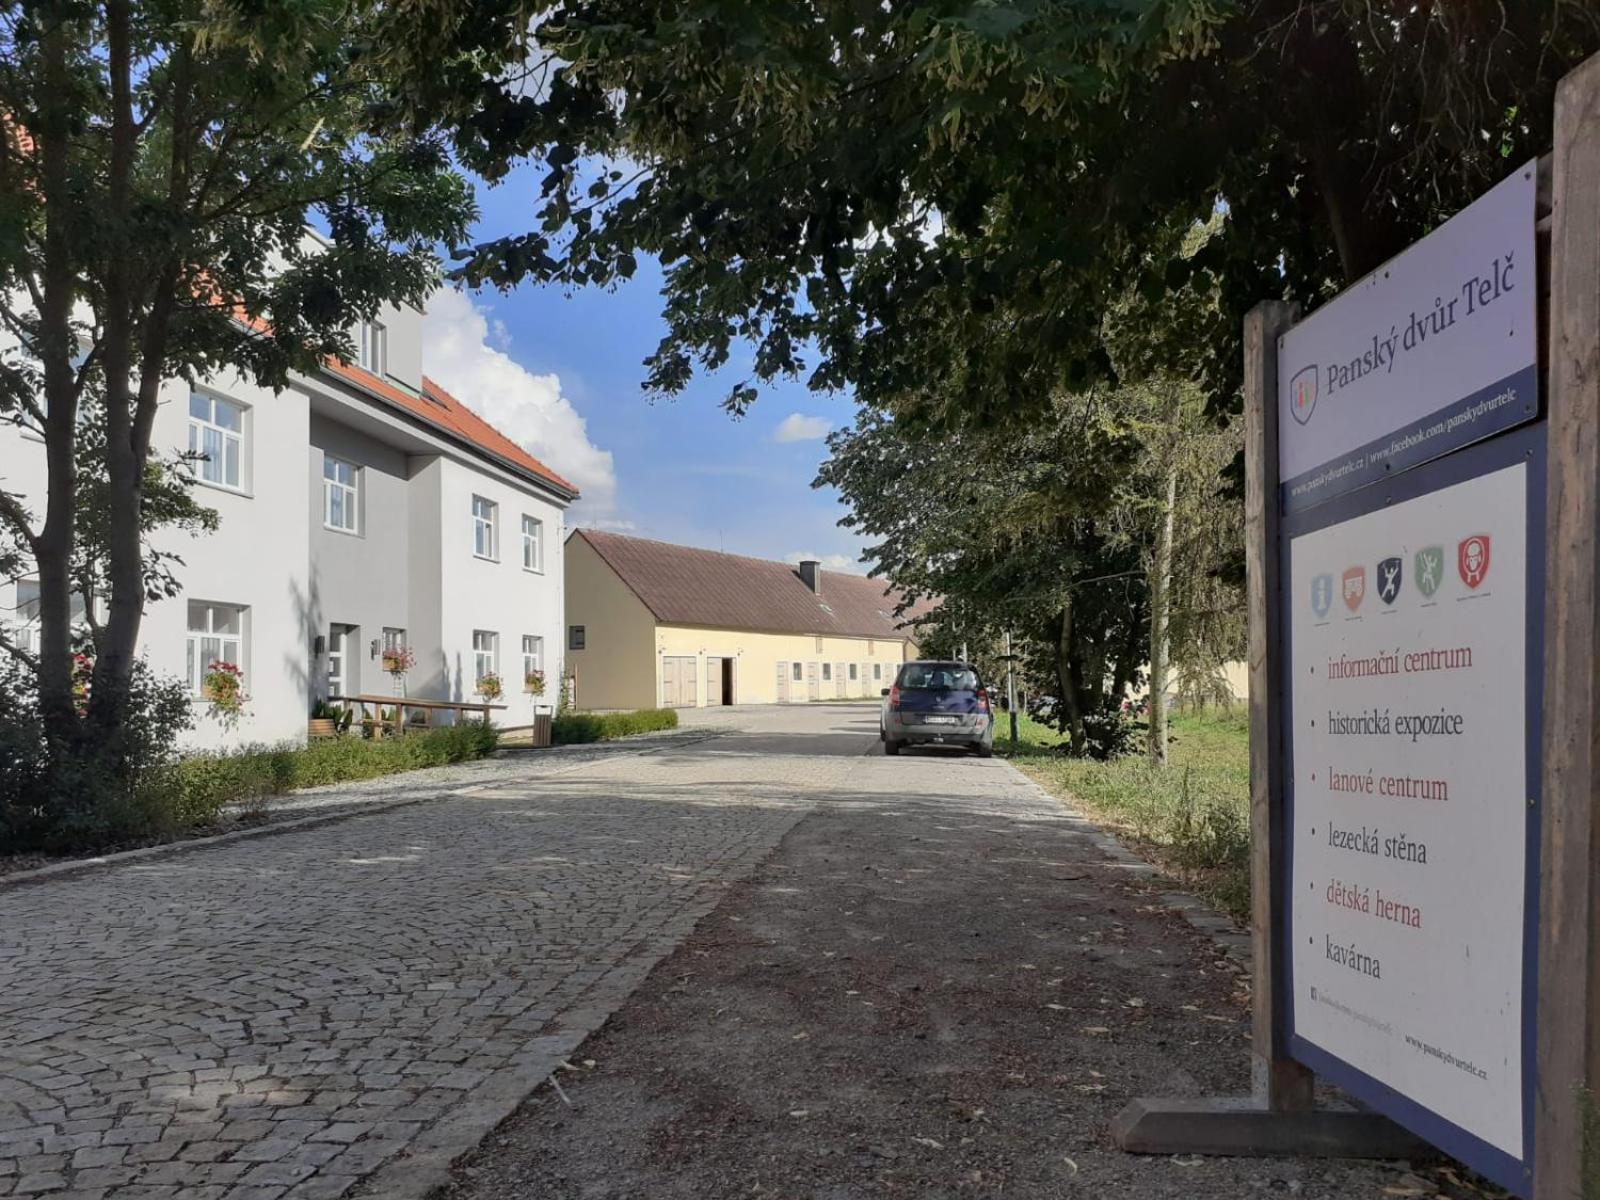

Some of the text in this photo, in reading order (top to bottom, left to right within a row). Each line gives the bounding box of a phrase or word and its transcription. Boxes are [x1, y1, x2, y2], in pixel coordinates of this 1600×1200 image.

[1326, 250, 1515, 395] Panský dvůr Telč
[1370, 387, 1517, 463] www.facebook.com/panskydvurtelc
[1328, 647, 1473, 679] informační centrum
[1328, 707, 1464, 742] historická expozice
[1329, 766, 1449, 801] lanové centrum
[1328, 821, 1428, 864] lezecká stěna
[1326, 879, 1422, 929] dětská herna
[1325, 934, 1381, 979] kavárna
